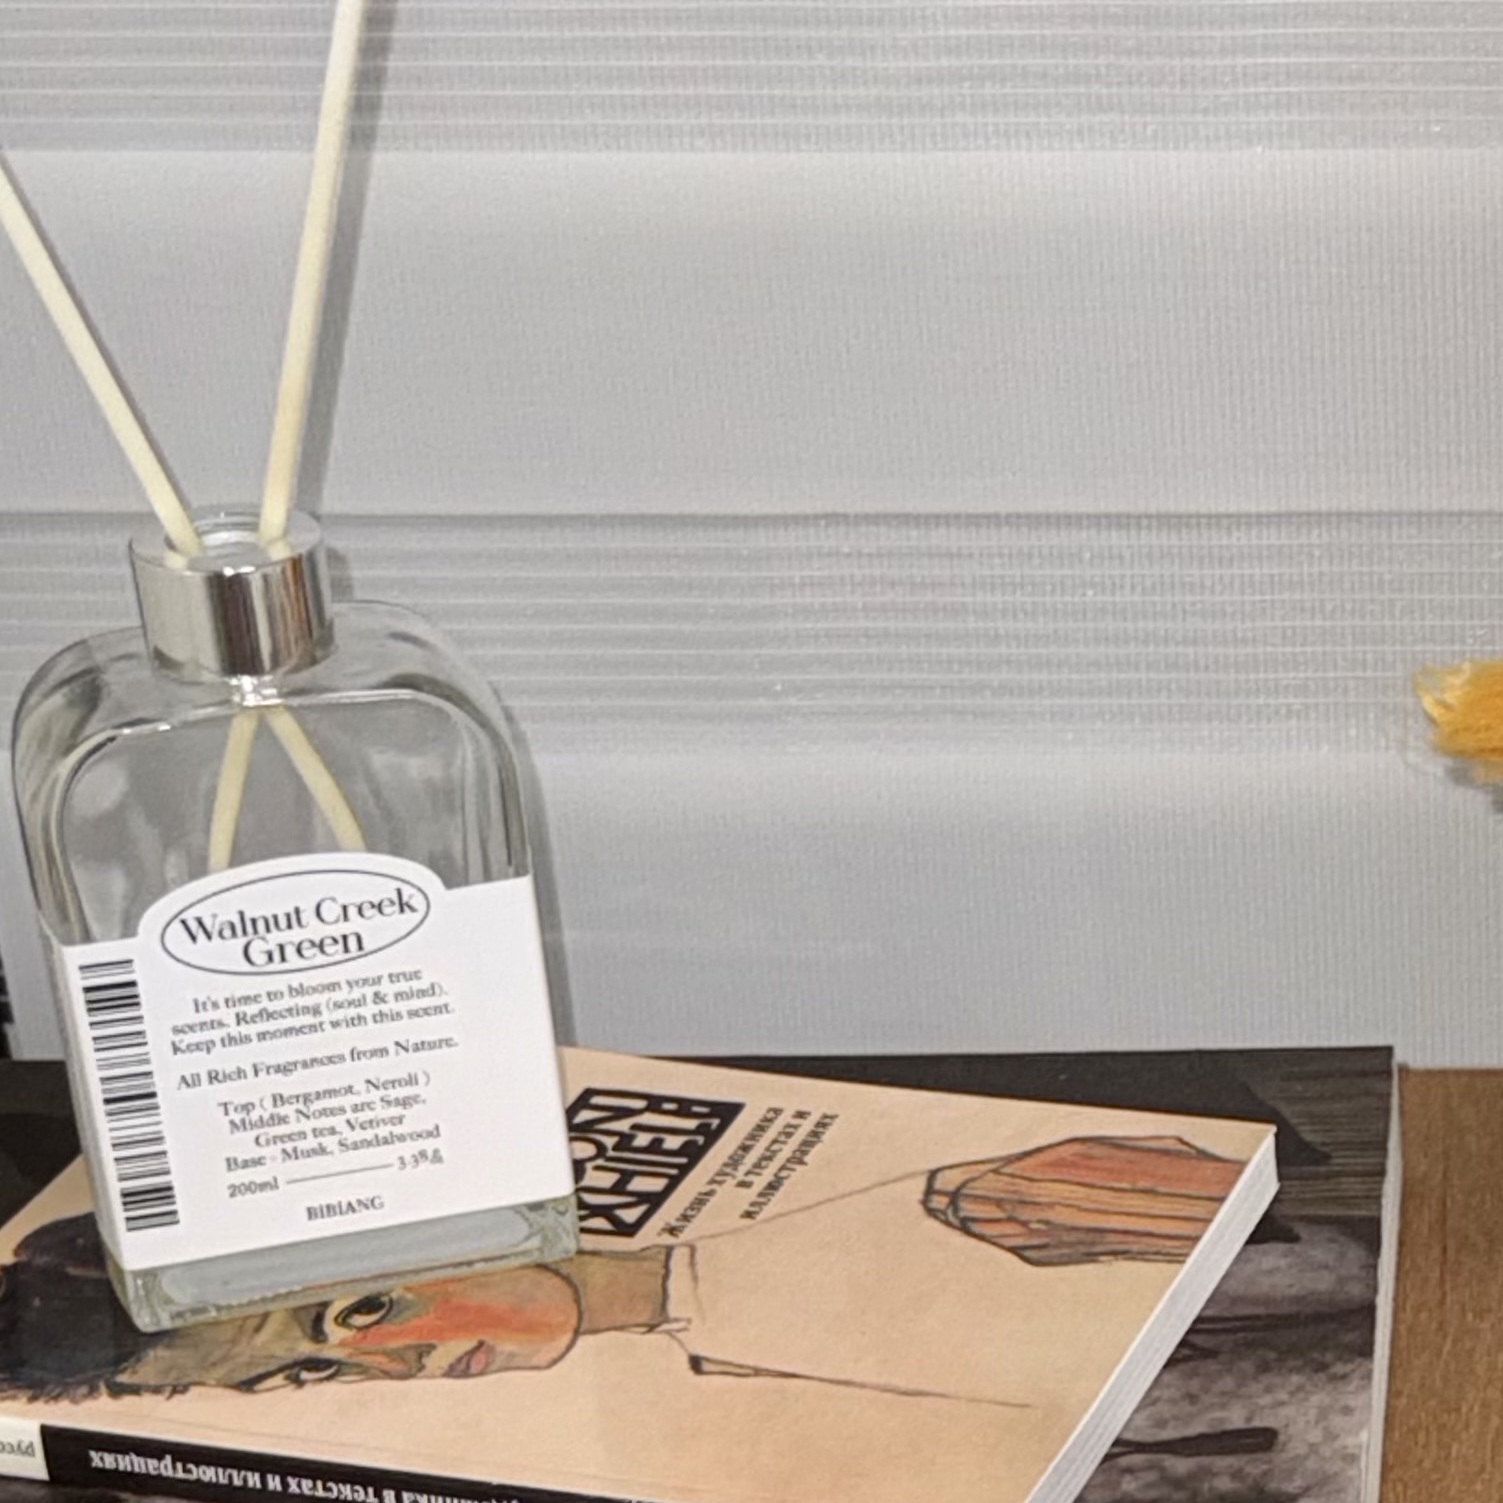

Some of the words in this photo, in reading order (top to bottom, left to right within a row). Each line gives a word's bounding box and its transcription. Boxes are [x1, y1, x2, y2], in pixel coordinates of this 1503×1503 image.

[179, 906, 308, 944] Walnut
[315, 888, 419, 925] Creek
[243, 930, 365, 967] Green
[171, 1016, 230, 1036] scents.
[234, 1000, 322, 1027] Reflecting
[326, 994, 367, 1013] (soul
[372, 991, 387, 1005] &
[192, 996, 220, 1014] It's
[224, 991, 262, 1010] time
[266, 990, 284, 1004] to
[288, 980, 341, 998] bloom
[345, 975, 383, 995] your
[387, 969, 423, 984] true
[170, 1037, 216, 1058] Keep
[221, 1029, 253, 1047] this
[256, 1021, 325, 1041] moment
[329, 1014, 367, 1030] with
[372, 1008, 403, 1025] this
[407, 1002, 455, 1019] scent.
[176, 1073, 201, 1091] All
[207, 1066, 248, 1086] Rich
[253, 1054, 347, 1078] Fragrances
[350, 1046, 389, 1062] from
[393, 1035, 459, 1053] Nature.
[217, 1100, 255, 1118] Top
[365, 1074, 420, 1093] Neroli
[228, 1114, 291, 1134] Middle
[295, 1106, 347, 1122] Notes
[351, 1101, 375, 1114] are
[379, 1093, 427, 1112] Sage,
[793, 1109, 812, 1123] и
[225, 1154, 267, 1172] Base
[338, 1125, 441, 1153] Sandalwood
[254, 1130, 308, 1148] Green
[345, 1115, 406, 1133] Vetiver
[744, 1122, 804, 1181] текстах
[227, 1177, 279, 1198] 200ml
[657, 1186, 717, 1239] Жизнь
[708, 1106, 785, 1187] художника
[735, 1178, 755, 1190] в
[739, 1111, 840, 1221] иллюстрациях
[306, 1196, 385, 1221] BIBIANG
[88, 1448, 262, 1490] иллюстрациях
[266, 1473, 282, 1493] и
